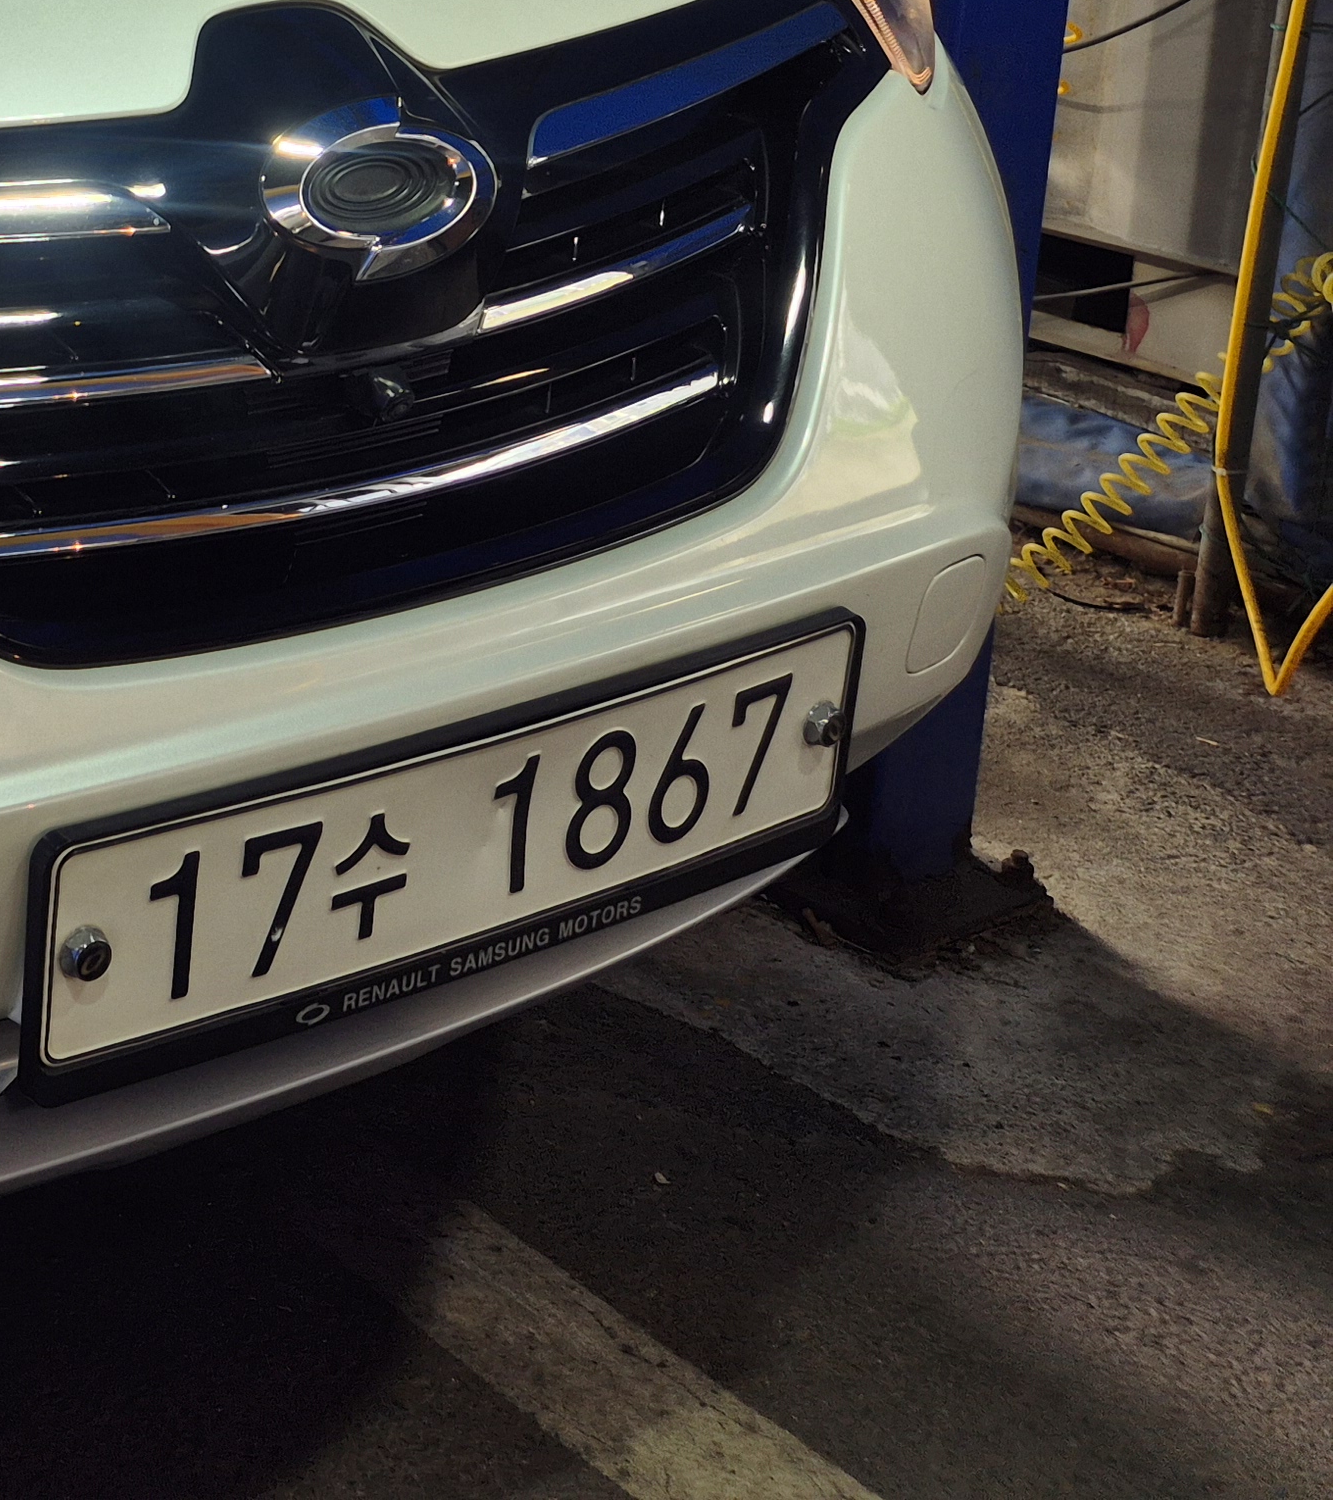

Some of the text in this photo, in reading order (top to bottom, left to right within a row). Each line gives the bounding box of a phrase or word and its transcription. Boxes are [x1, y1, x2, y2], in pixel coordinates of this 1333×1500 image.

[148, 672, 795, 1000] 17수 1867
[342, 895, 642, 1012] RENAULT SAMSUNG MOTORS
